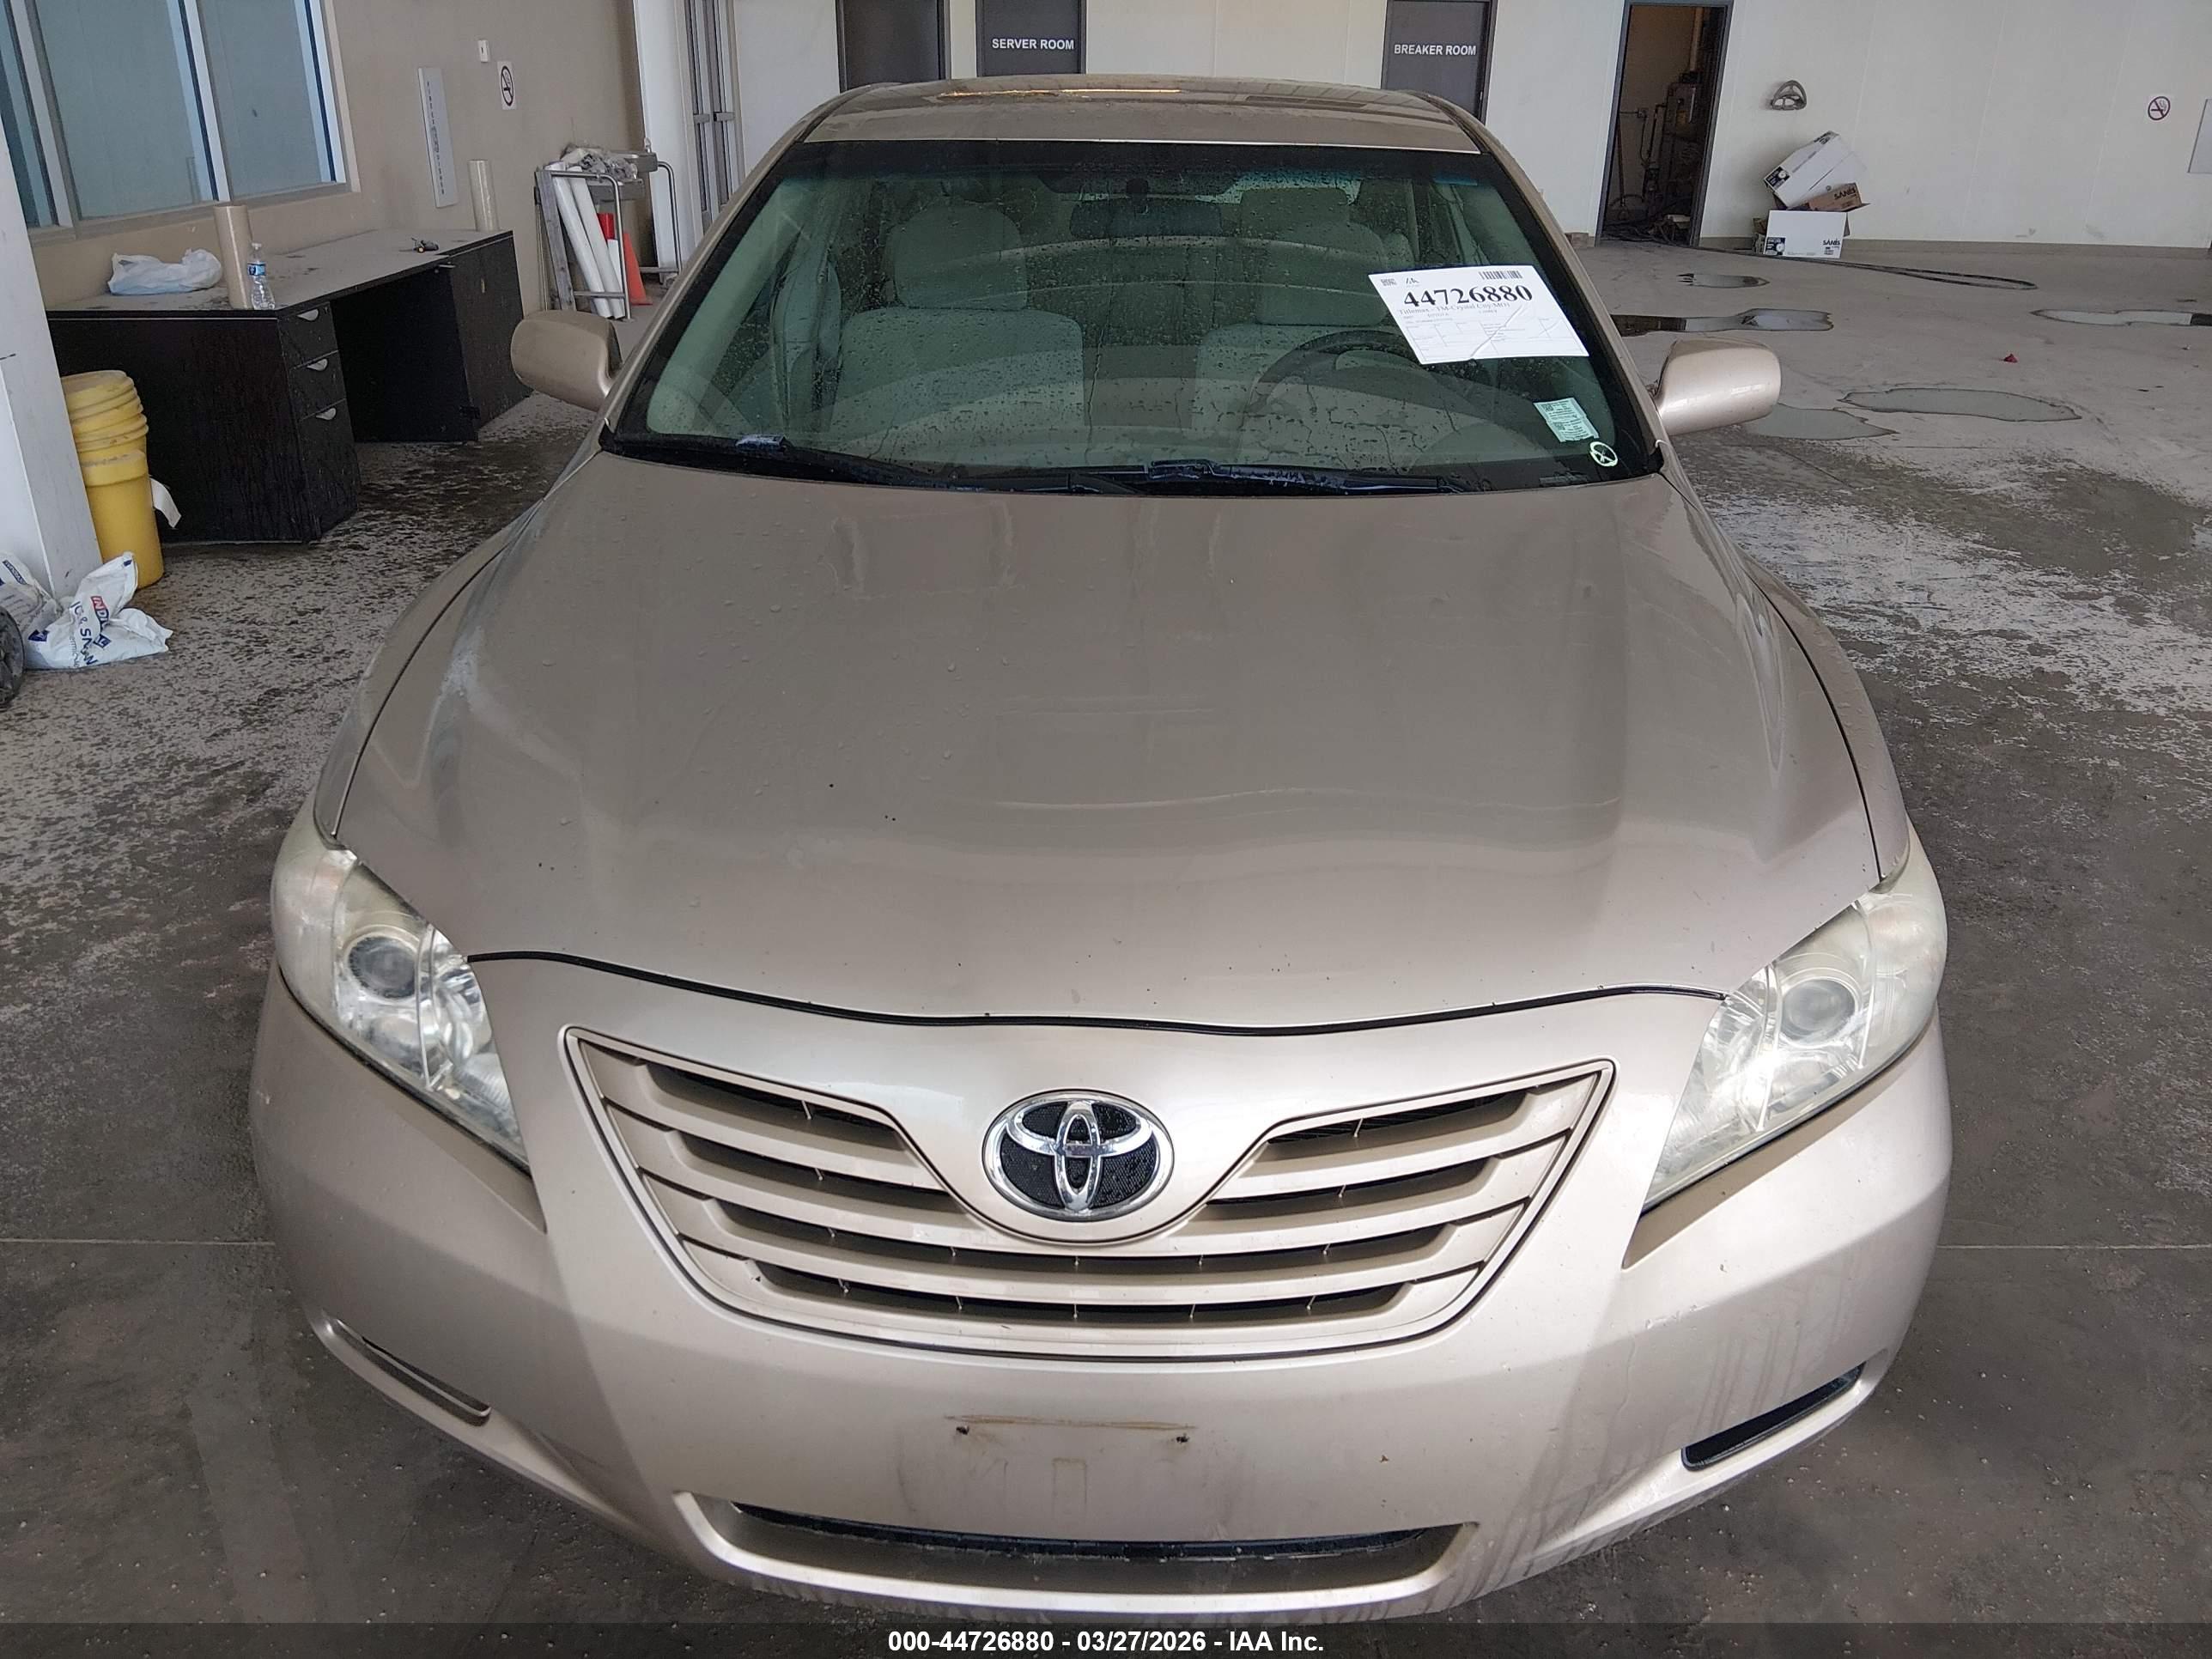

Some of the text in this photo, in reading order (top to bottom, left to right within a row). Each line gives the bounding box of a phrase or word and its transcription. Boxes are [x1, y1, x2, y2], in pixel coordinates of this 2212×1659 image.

[992, 38, 1074, 50] SERVER ROOM
[1394, 44, 1476, 56] BREAKER ROOM
[1404, 284, 1533, 307] 44726880
